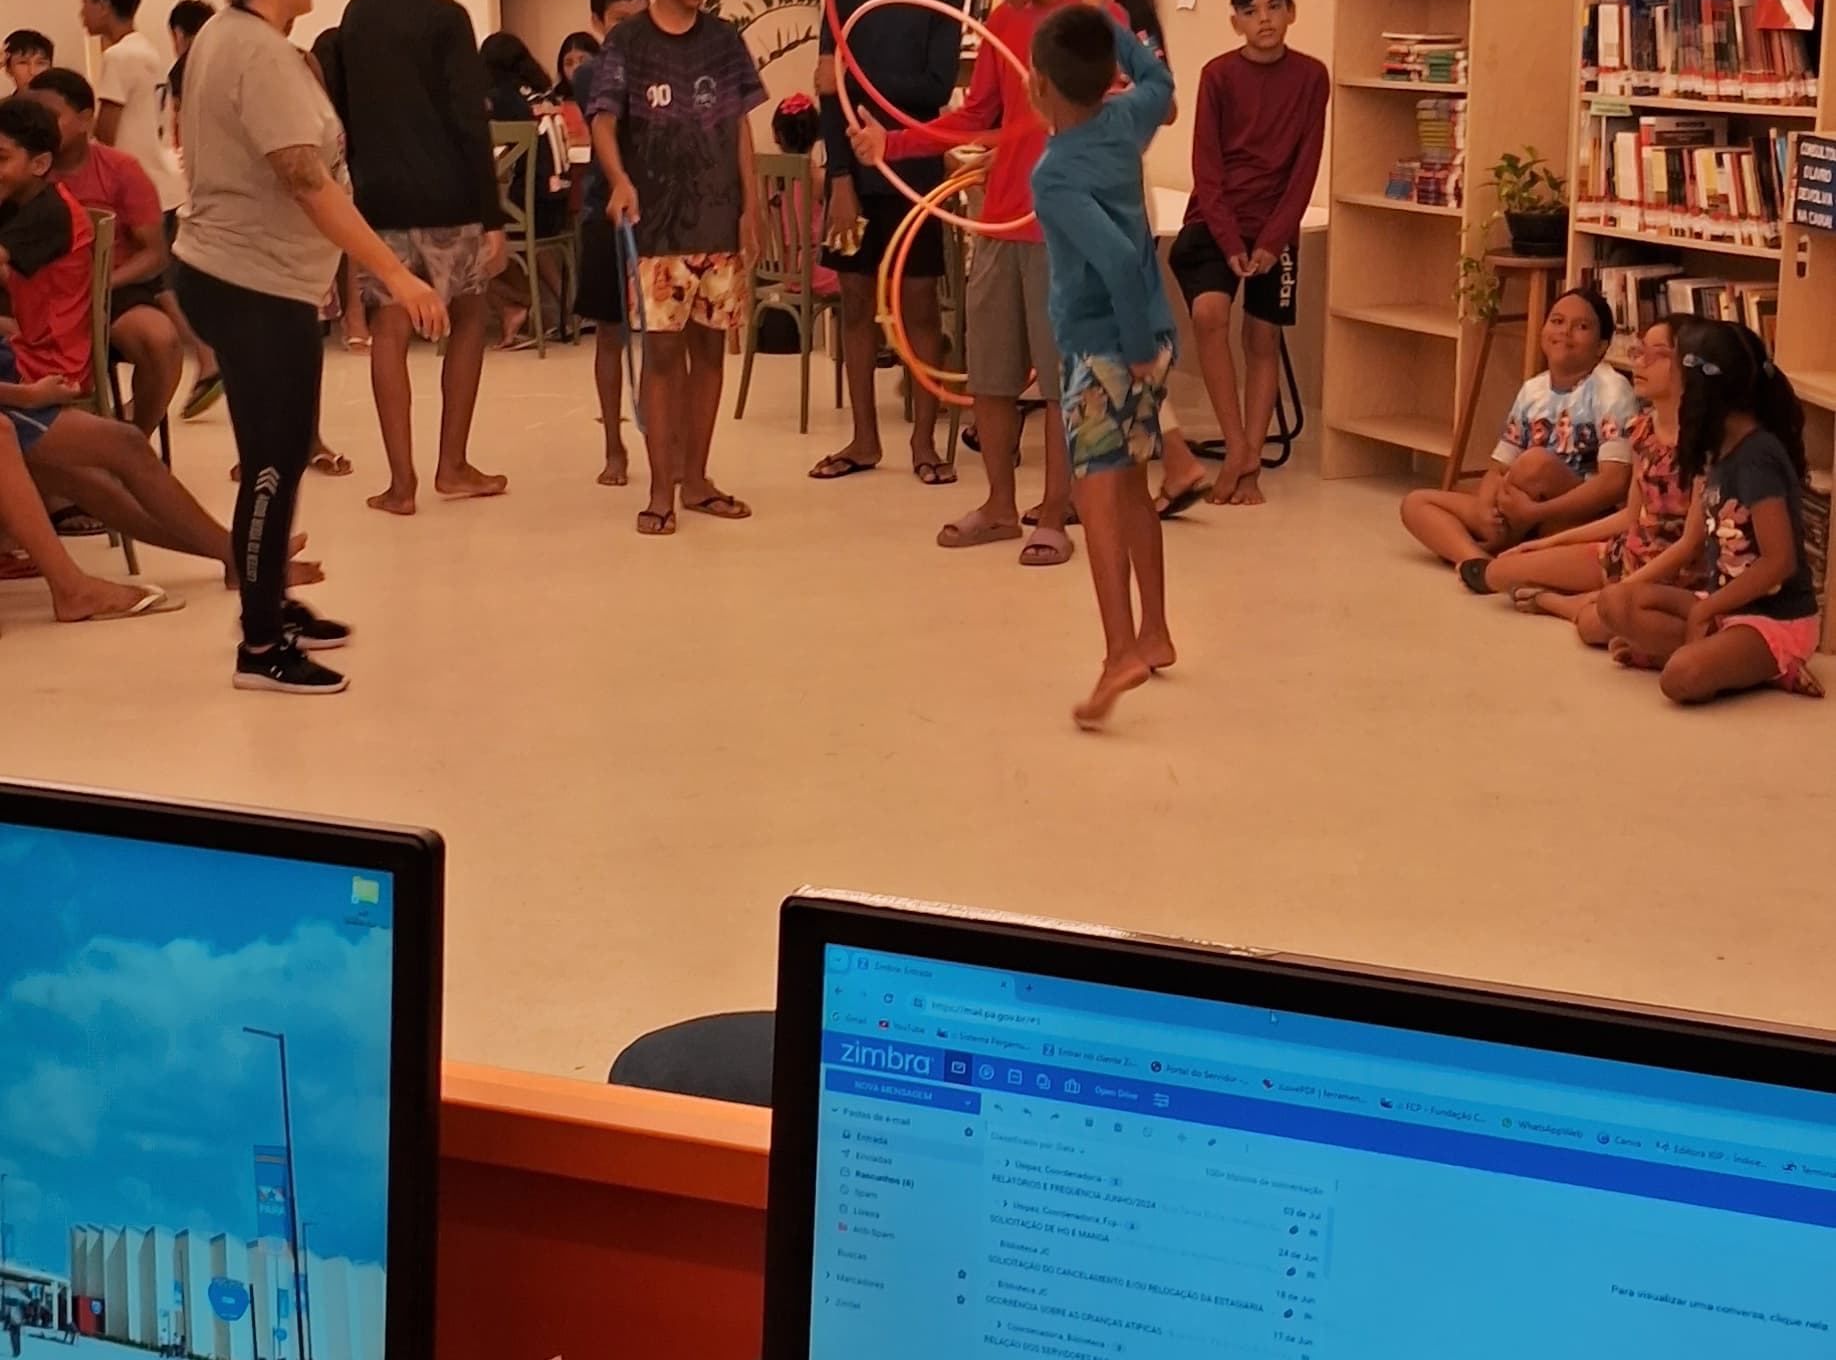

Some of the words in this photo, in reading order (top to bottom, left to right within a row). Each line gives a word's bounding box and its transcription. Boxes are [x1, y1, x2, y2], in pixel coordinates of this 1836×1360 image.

[840, 1040, 930, 1075] zimbra
[1611, 1284, 1635, 1297] Para
[1637, 1290, 1687, 1306] visualizar
[1689, 1300, 1714, 1311] uma
[1770, 1313, 1803, 1328] clique
